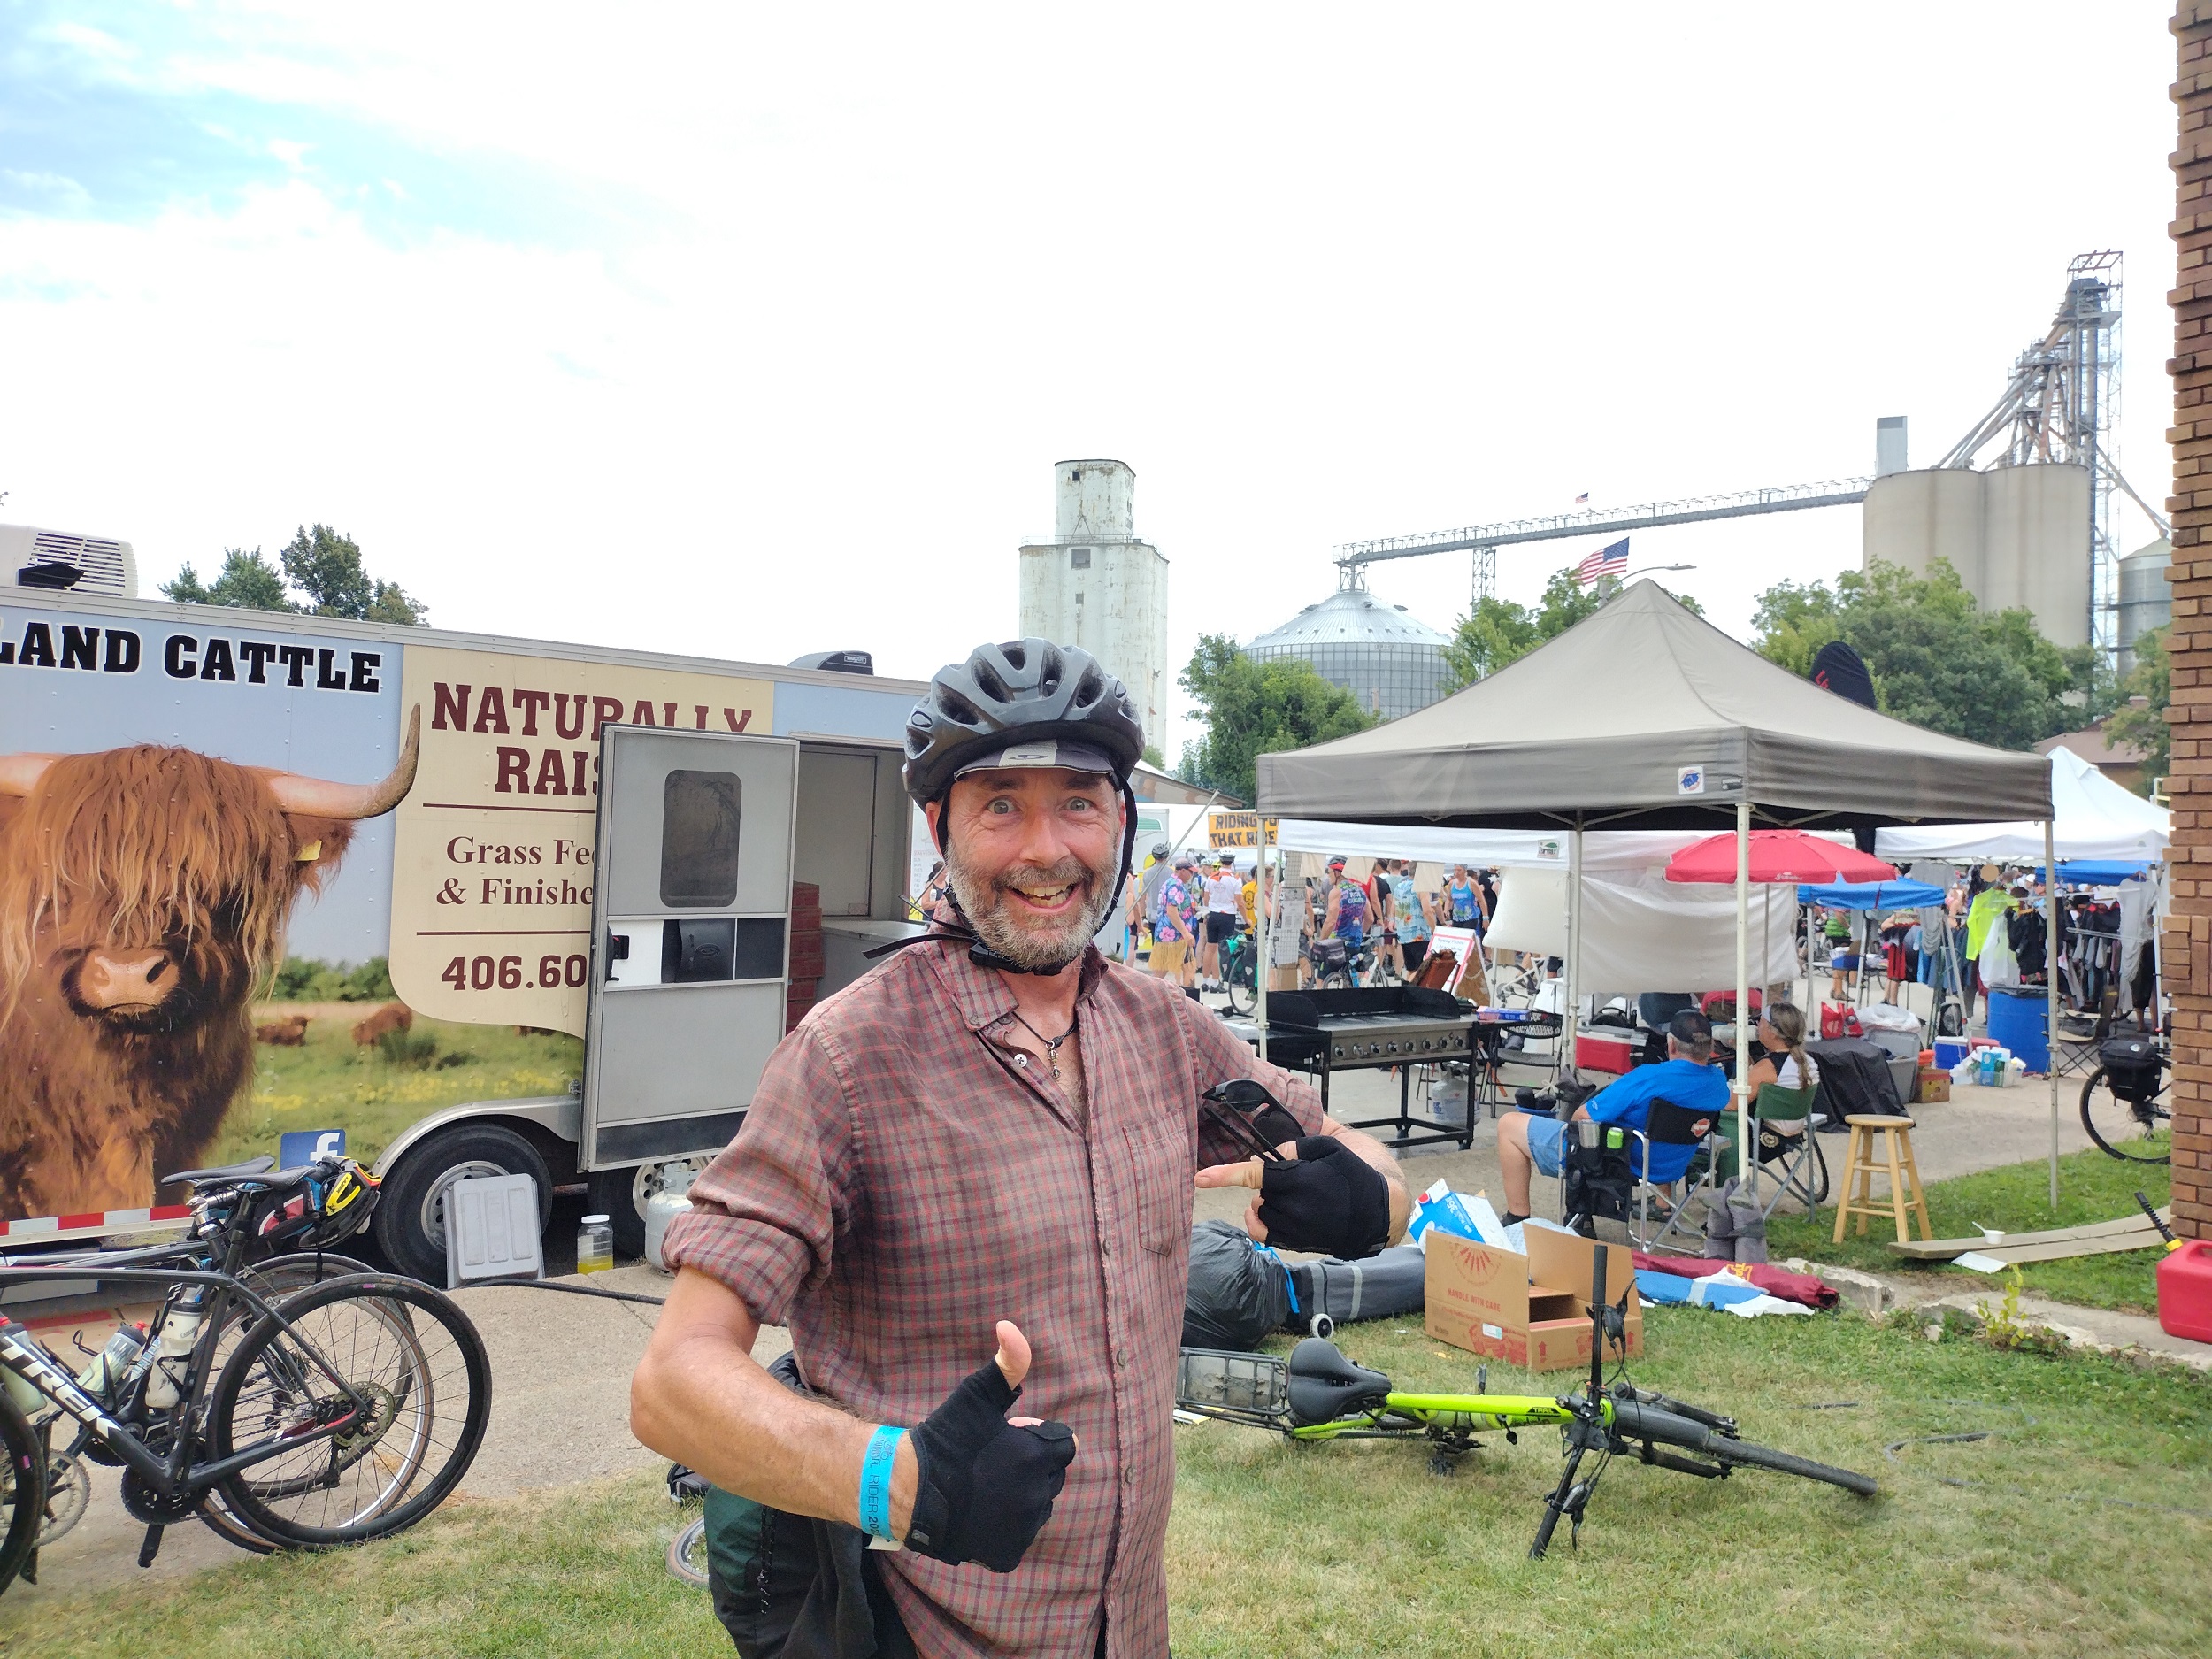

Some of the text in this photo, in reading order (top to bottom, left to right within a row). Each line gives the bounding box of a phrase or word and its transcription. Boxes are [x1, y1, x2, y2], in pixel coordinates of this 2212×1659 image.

[165, 634, 380, 693] CATTLE
[495, 746, 599, 796] RAI
[1216, 813, 1257, 830] RIDING
[447, 836, 595, 865] Grass Fe
[1210, 831, 1242, 847] THAT
[436, 878, 467, 905] &
[442, 954, 588, 991] 406.60
[1448, 1287, 1502, 1313] HANDLE WITH CARE
[1, 1335, 122, 1440] TREK
[867, 1474, 880, 1513] RIDER
[867, 1515, 882, 1537] 202
